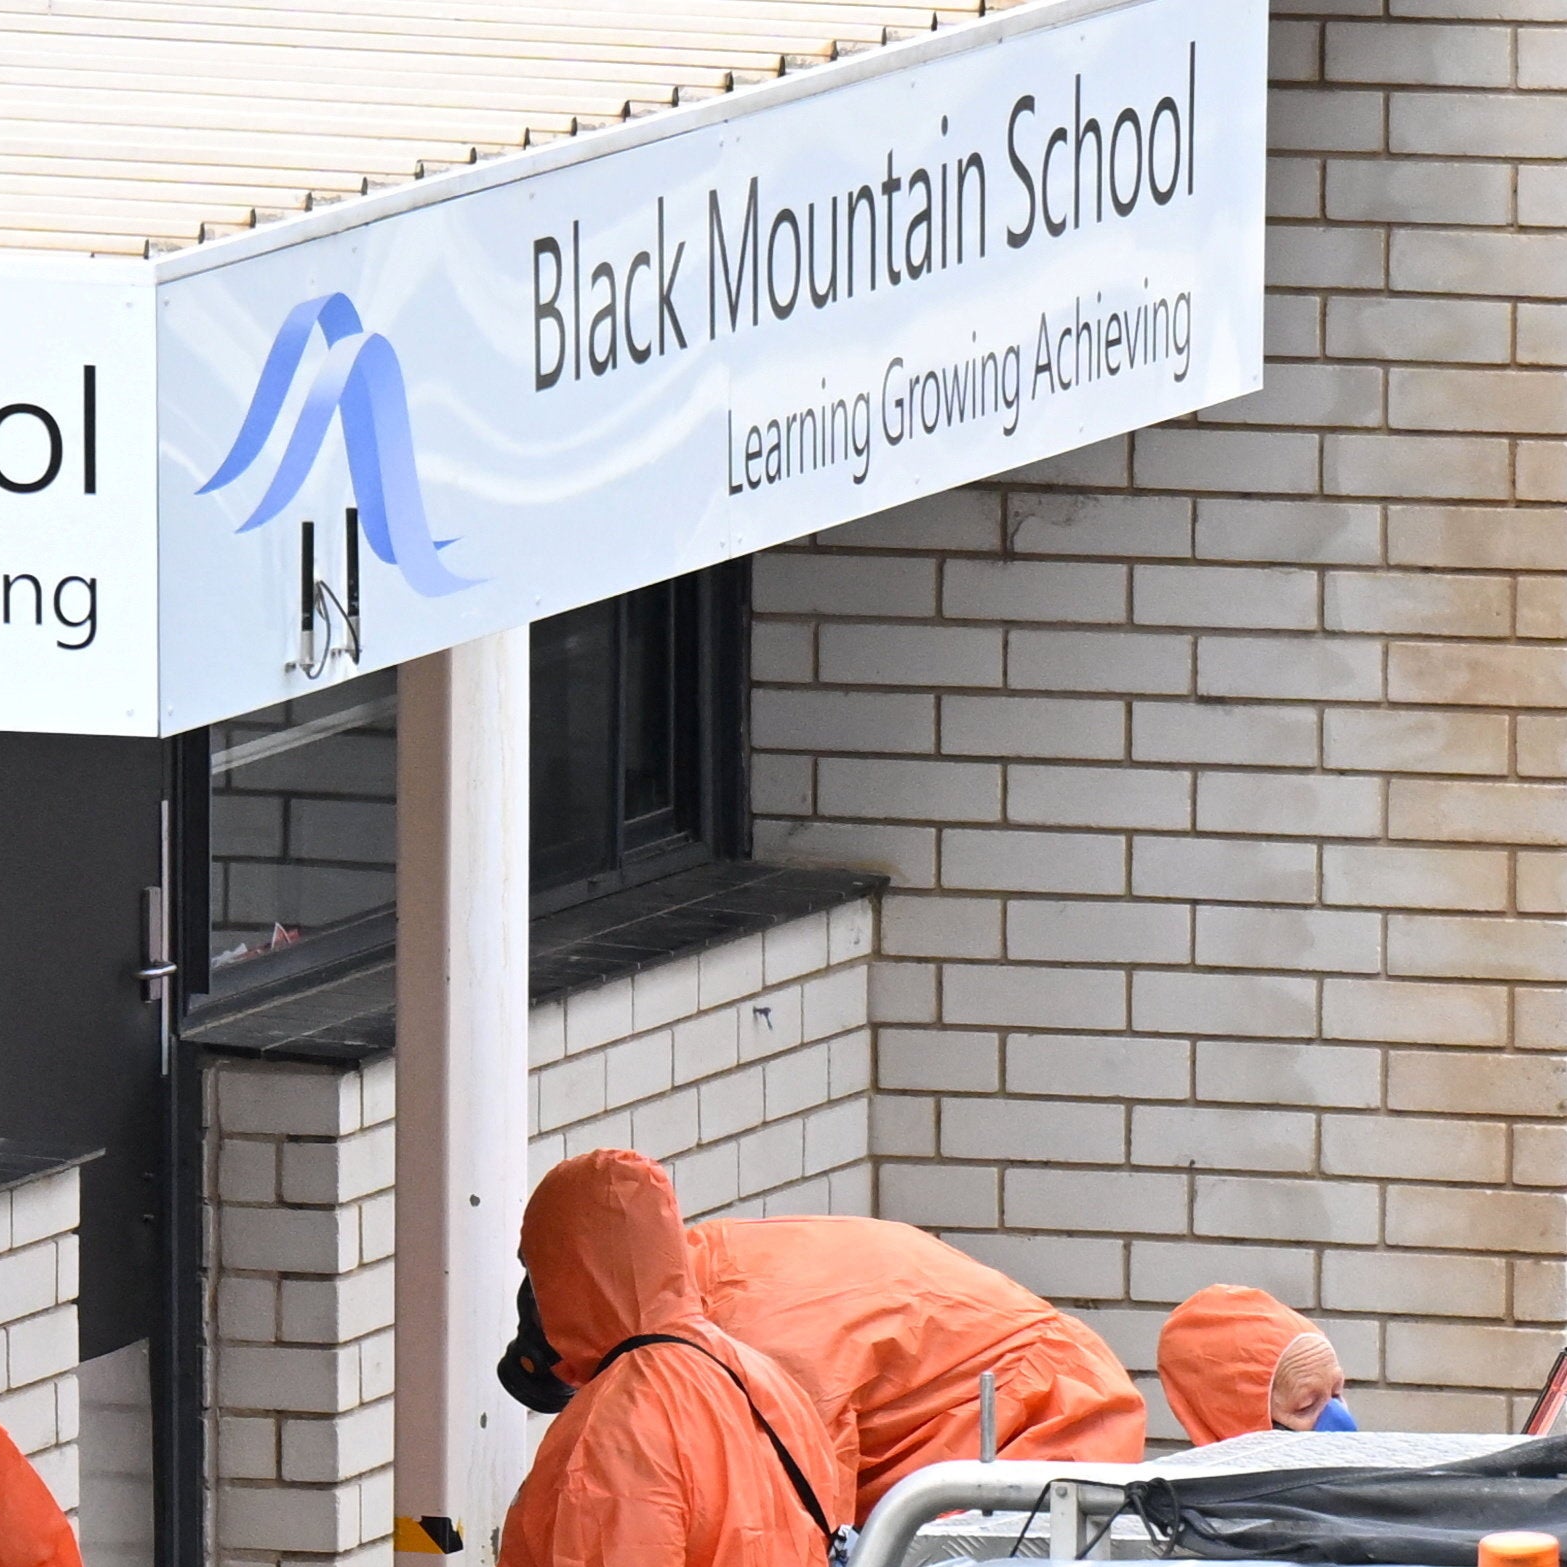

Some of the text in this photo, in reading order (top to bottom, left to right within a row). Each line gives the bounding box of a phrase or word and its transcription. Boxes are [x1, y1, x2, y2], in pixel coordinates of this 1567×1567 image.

[533, 40, 1196, 393] Black Mountain School
[728, 277, 1191, 496] Learning Growing Achieving
